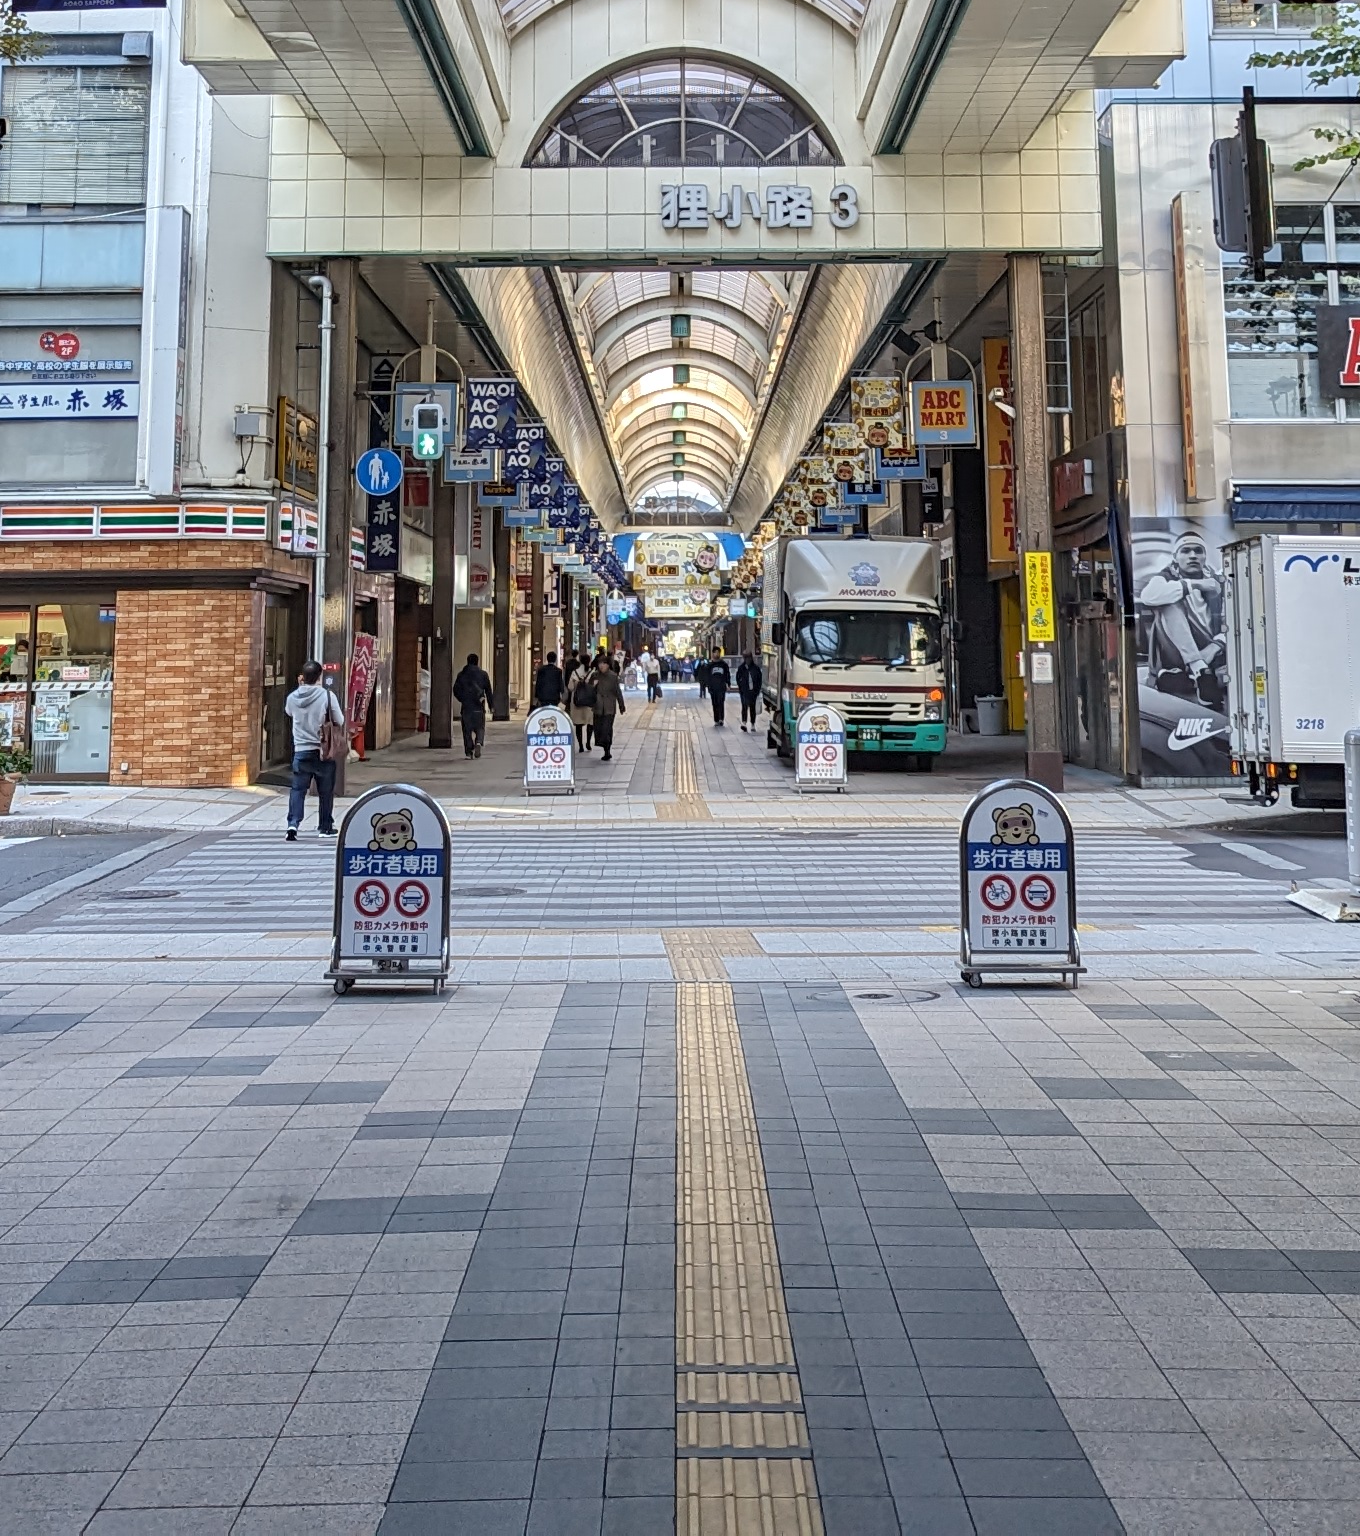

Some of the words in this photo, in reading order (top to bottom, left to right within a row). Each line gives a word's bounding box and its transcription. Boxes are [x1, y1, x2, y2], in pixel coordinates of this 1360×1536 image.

[660, 183, 814, 230] 狸小路
[828, 183, 860, 229] 3
[469, 383, 516, 398] WAO!
[65, 388, 129, 413] 赤塚
[922, 390, 961, 409] ABC
[920, 412, 967, 427] MART
[487, 432, 496, 445] 3
[939, 431, 948, 440] 3
[466, 470, 474, 479] 3
[522, 469, 530, 479] 3
[897, 468, 905, 477] 3
[370, 499, 397, 559] 赤塚
[839, 588, 897, 598] MOMOTARO
[850, 692, 888, 701] ISUZU
[1175, 718, 1214, 738] NIKE
[1295, 718, 1326, 731] 3218
[348, 853, 438, 876] 歩行者専用
[972, 848, 1062, 870] 歩行者専用
[353, 920, 429, 932] 防犯カメラ作動中
[981, 914, 1057, 926] 防犯カメラ作動中
